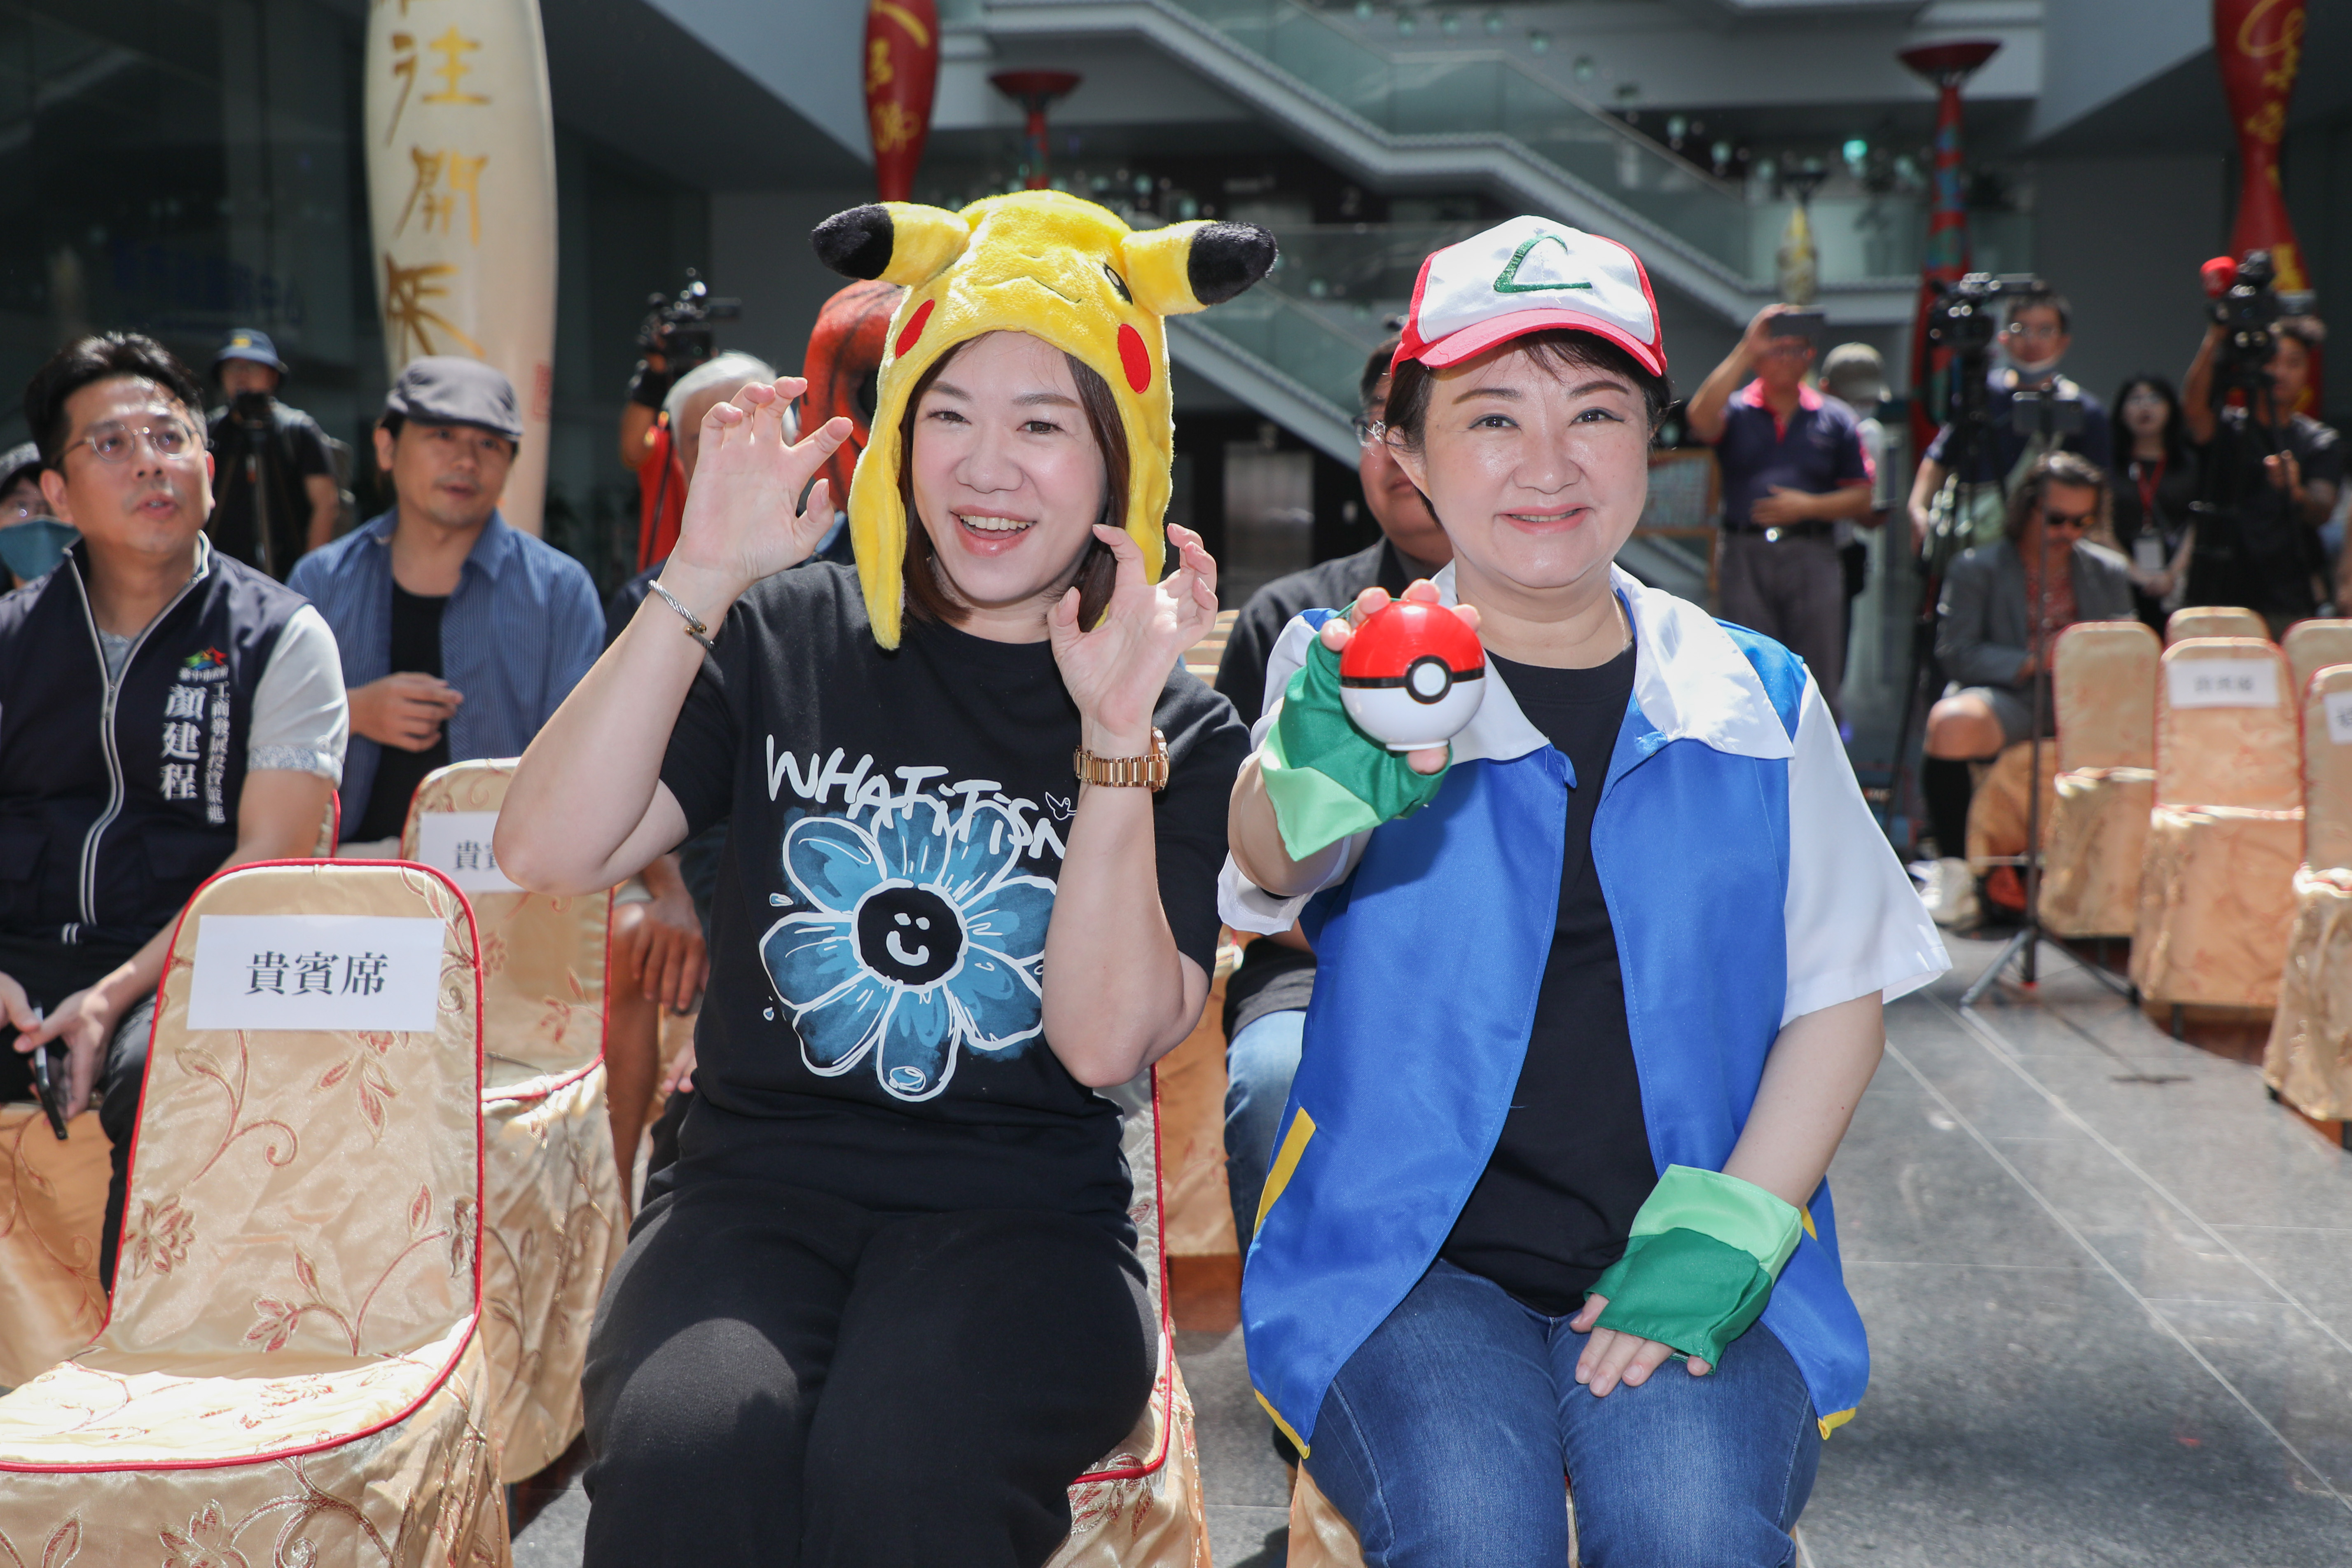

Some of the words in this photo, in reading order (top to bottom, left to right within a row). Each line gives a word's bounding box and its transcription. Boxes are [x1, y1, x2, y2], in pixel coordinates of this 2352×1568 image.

[766, 734, 949, 829] WHAT
[245, 951, 389, 996] 貴賓席
